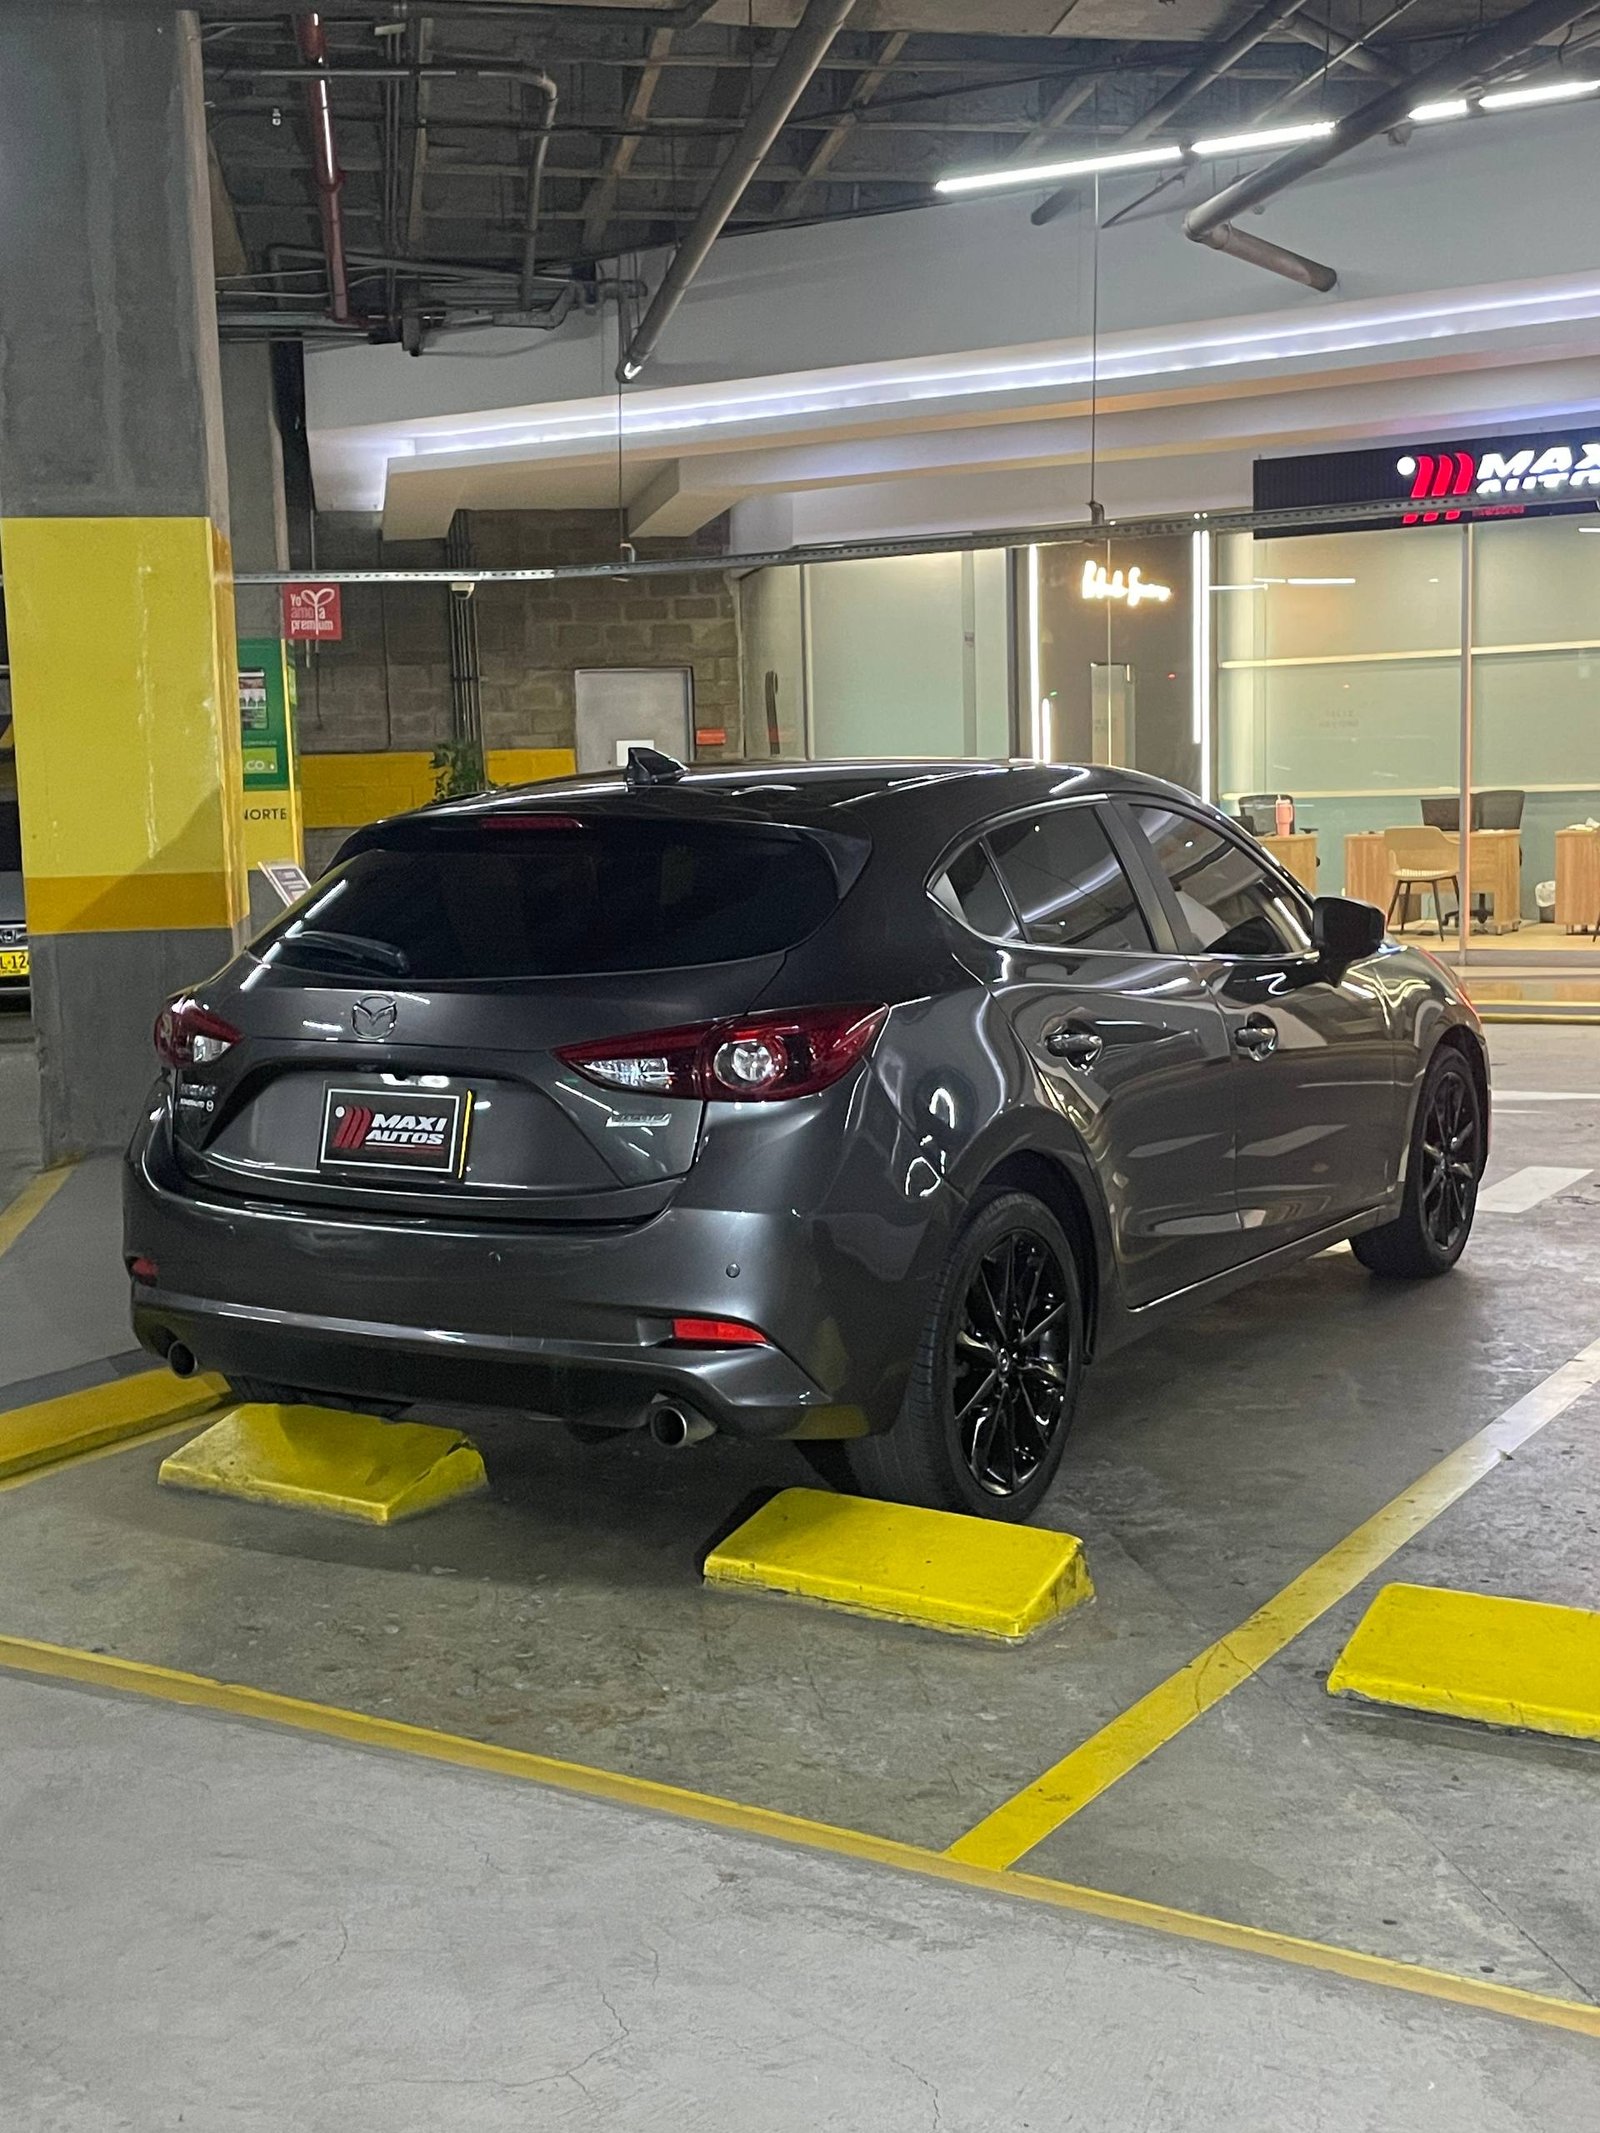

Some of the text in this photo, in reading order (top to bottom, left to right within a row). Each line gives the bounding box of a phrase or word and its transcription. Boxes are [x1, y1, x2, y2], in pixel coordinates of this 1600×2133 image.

[290, 593, 301, 607] Yo
[290, 606, 314, 619] amo
[290, 620, 334, 635] premium
[371, 1113, 448, 1132] MAXI
[365, 1129, 445, 1145] AUTOS
